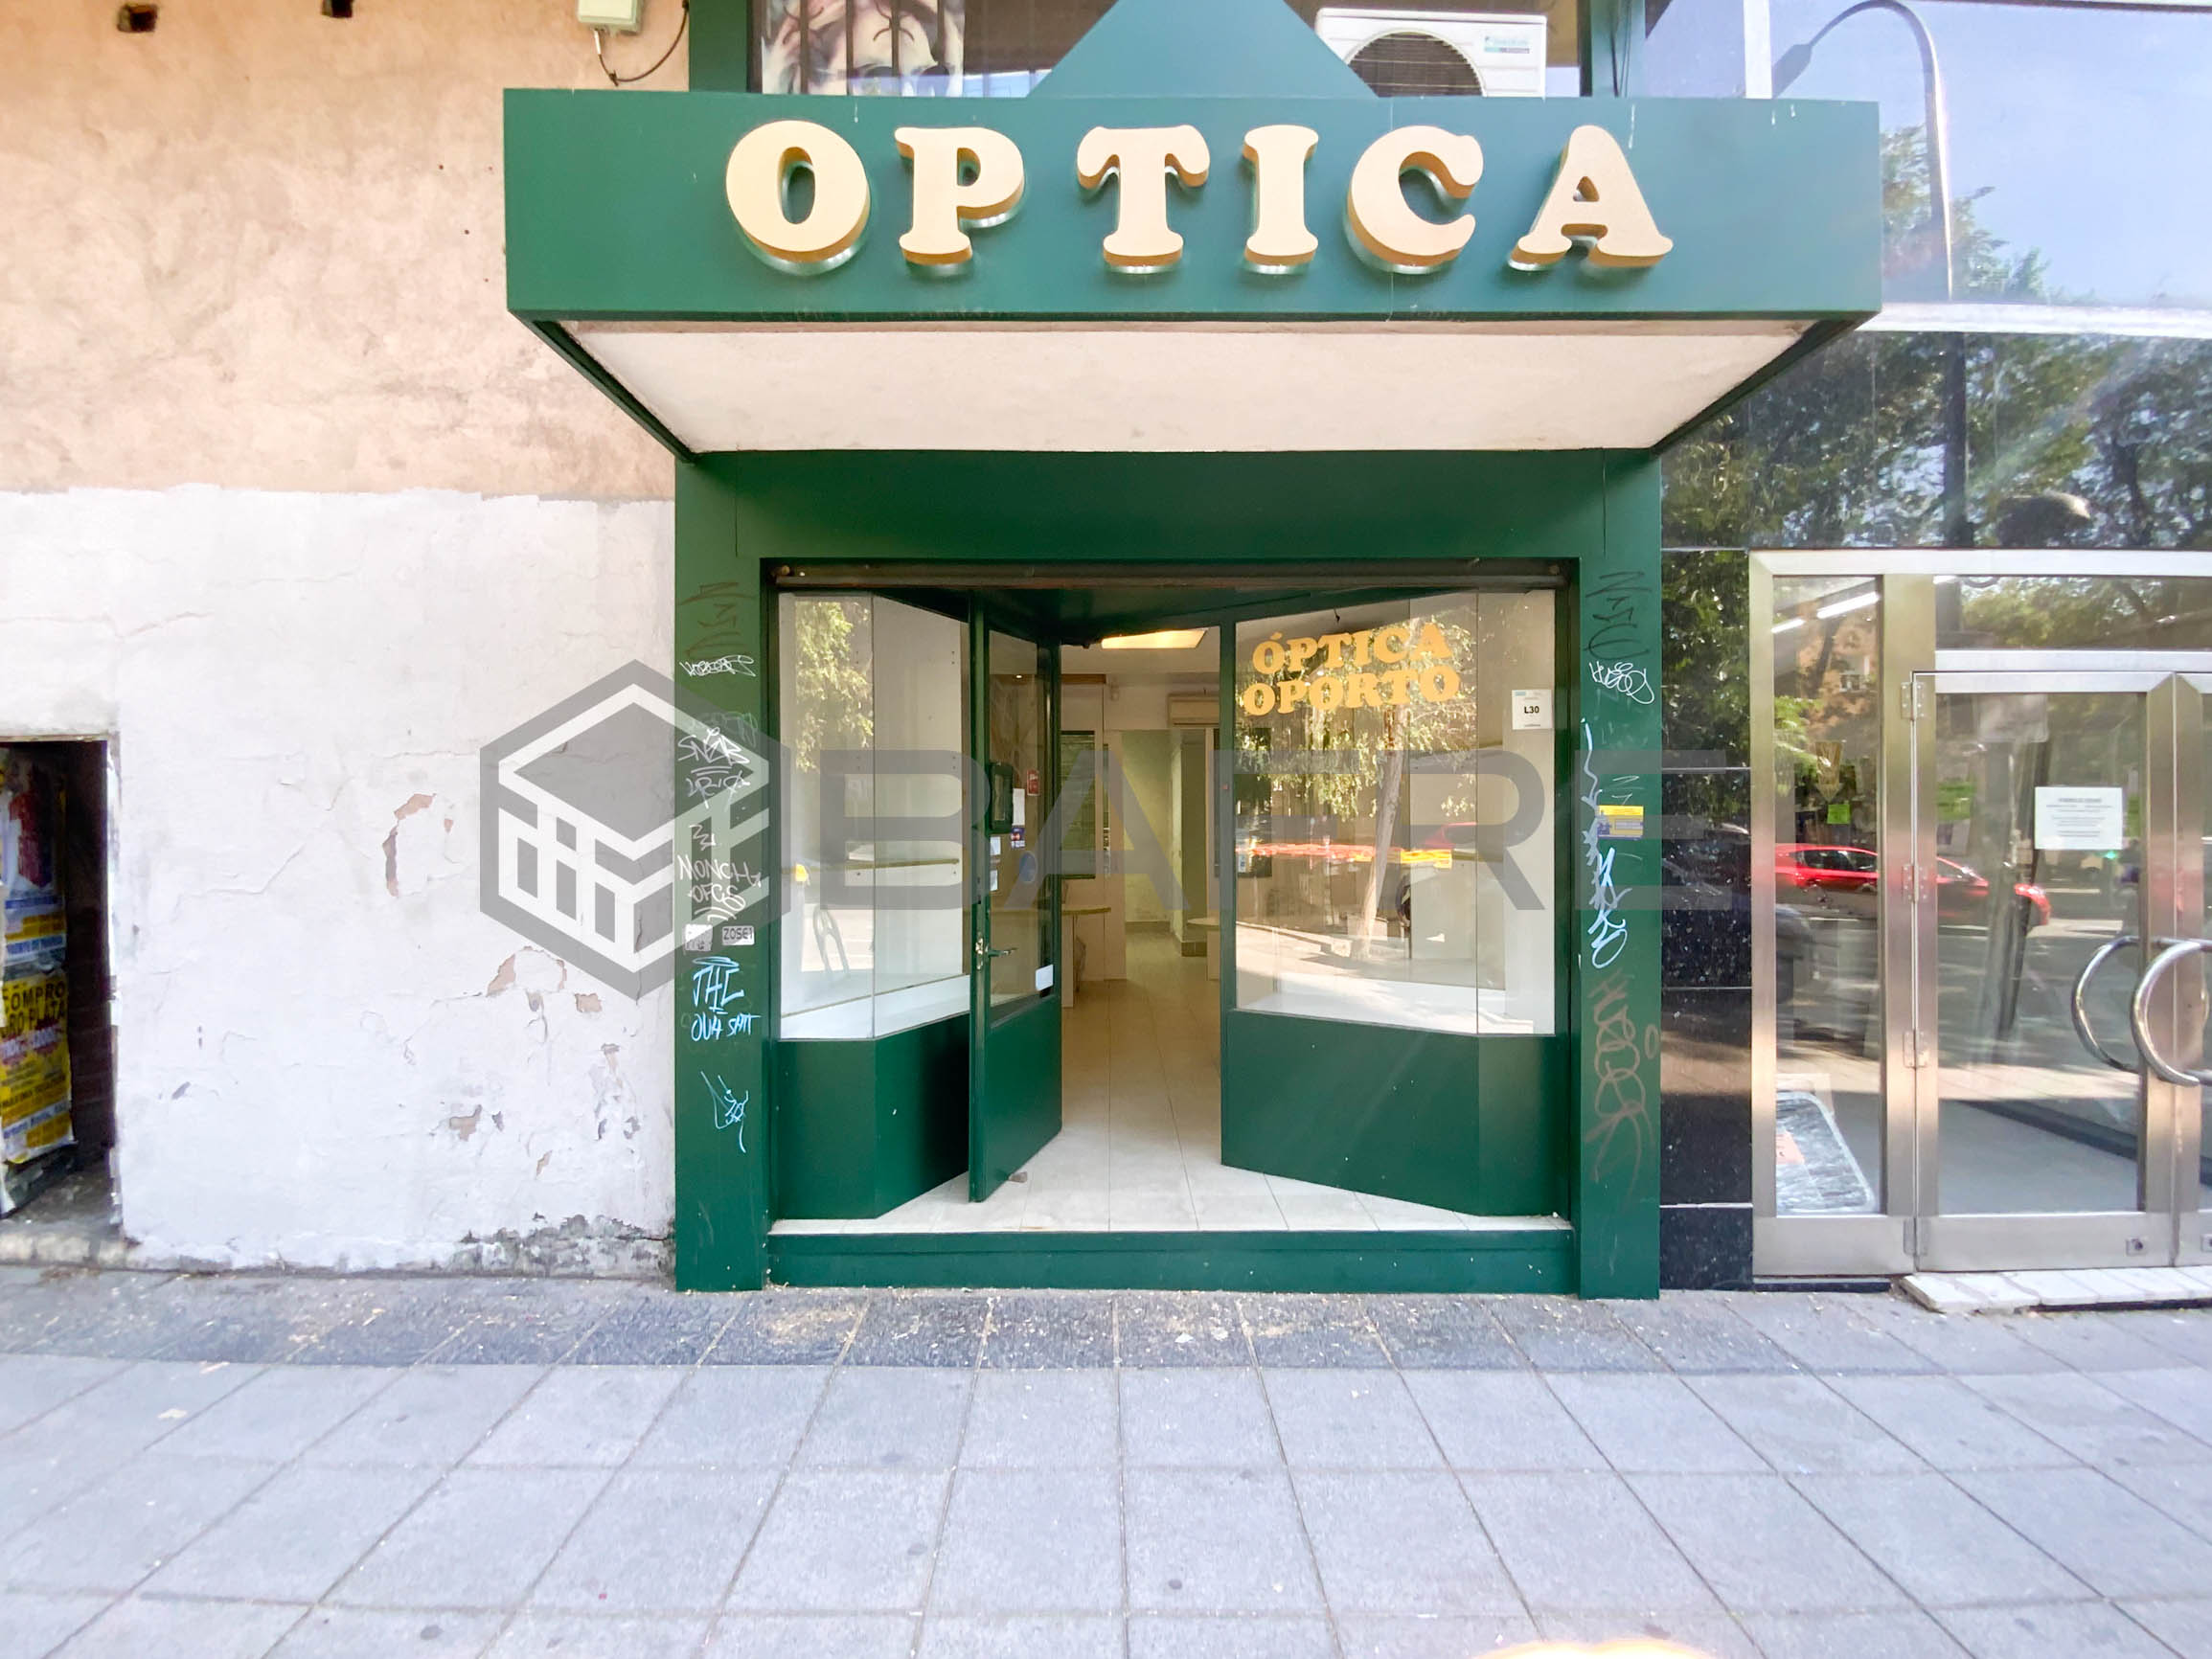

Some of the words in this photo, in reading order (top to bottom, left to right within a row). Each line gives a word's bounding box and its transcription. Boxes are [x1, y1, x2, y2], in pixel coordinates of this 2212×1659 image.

[725, 120, 1674, 267] OPTICA
[1252, 622, 1452, 674] ÓPTICA
[1243, 665, 1460, 716] OPORTO
[1523, 705, 1540, 715] L30
